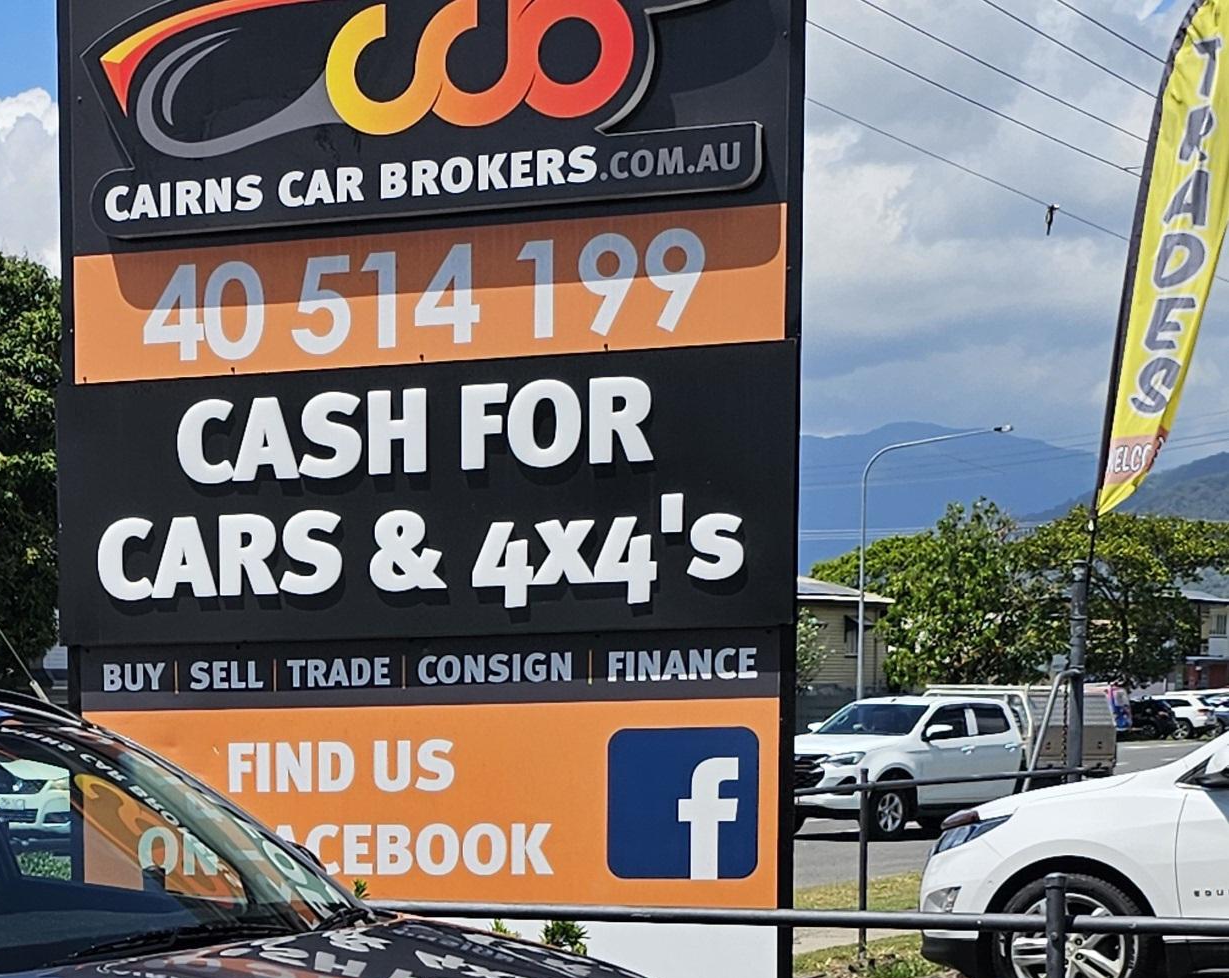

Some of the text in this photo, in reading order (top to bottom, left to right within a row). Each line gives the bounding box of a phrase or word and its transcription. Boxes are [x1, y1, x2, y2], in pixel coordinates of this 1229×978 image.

[104, 174, 264, 222] CAIRNS
[278, 166, 365, 208] CAR
[1131, 37, 1221, 414] TRADES
[143, 228, 706, 361] 40 514 199
[177, 377, 653, 484] CASH FOR
[97, 509, 343, 600] CARS
[370, 509, 447, 592] &
[103, 647, 758, 692] BUY SELL TRADE CONSIGN FINANCE
[227, 738, 455, 793] FIND US
